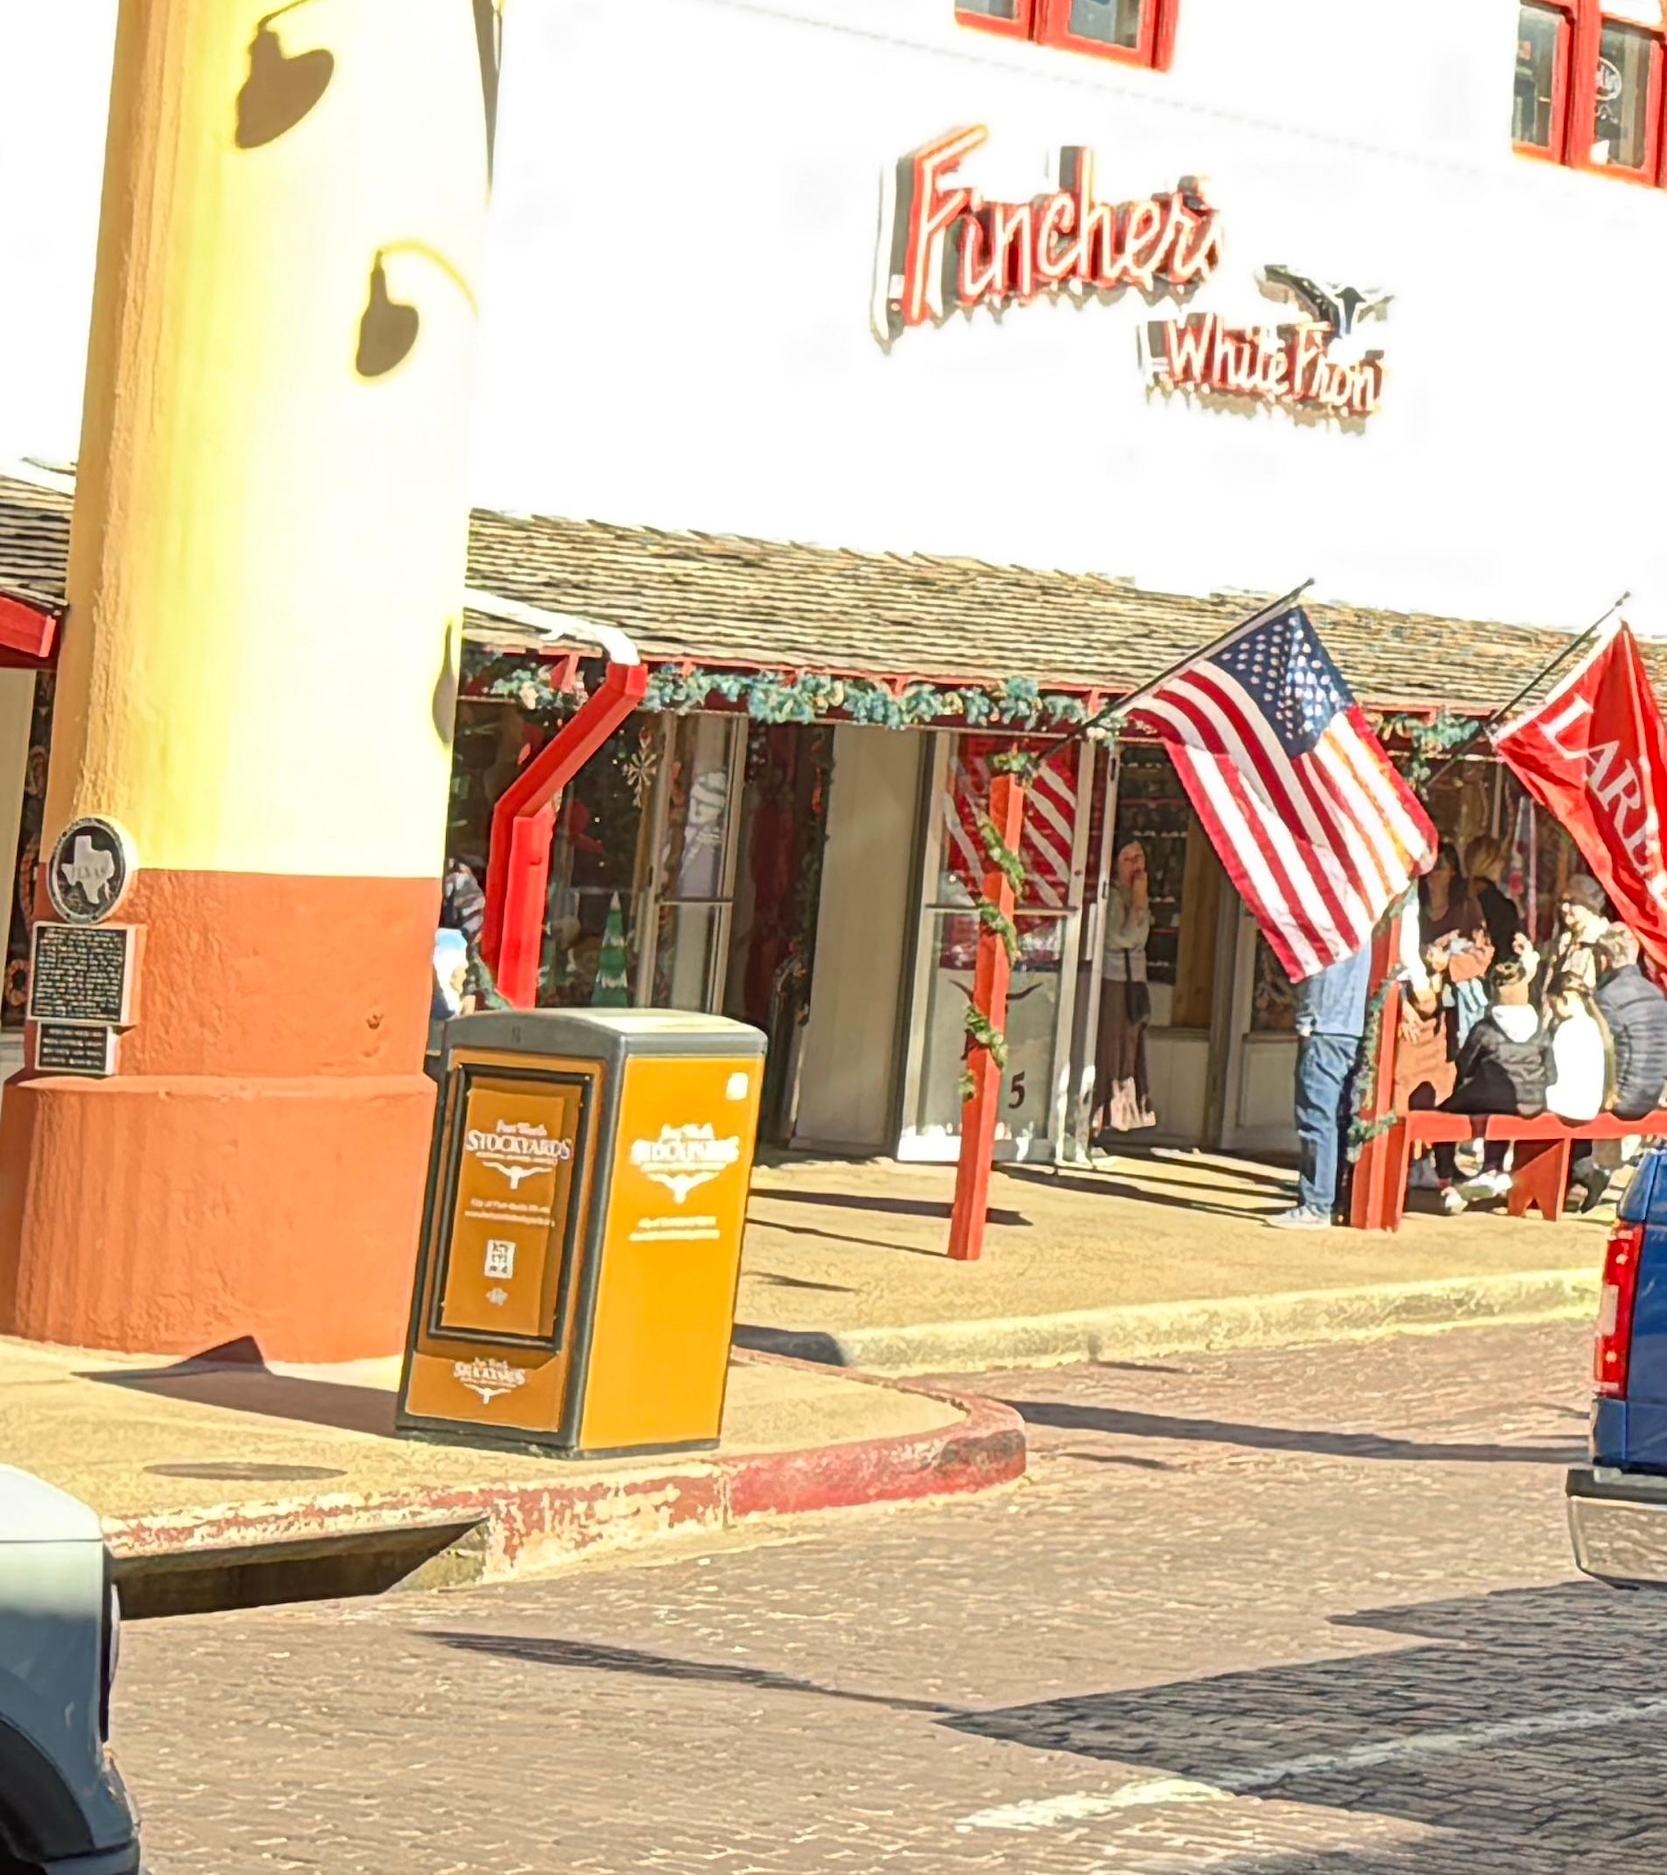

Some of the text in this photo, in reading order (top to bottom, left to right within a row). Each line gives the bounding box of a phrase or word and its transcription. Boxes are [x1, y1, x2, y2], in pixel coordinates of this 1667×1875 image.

[1164, 311, 1388, 415] White Fron
[1008, 1070, 1026, 1109] 5
